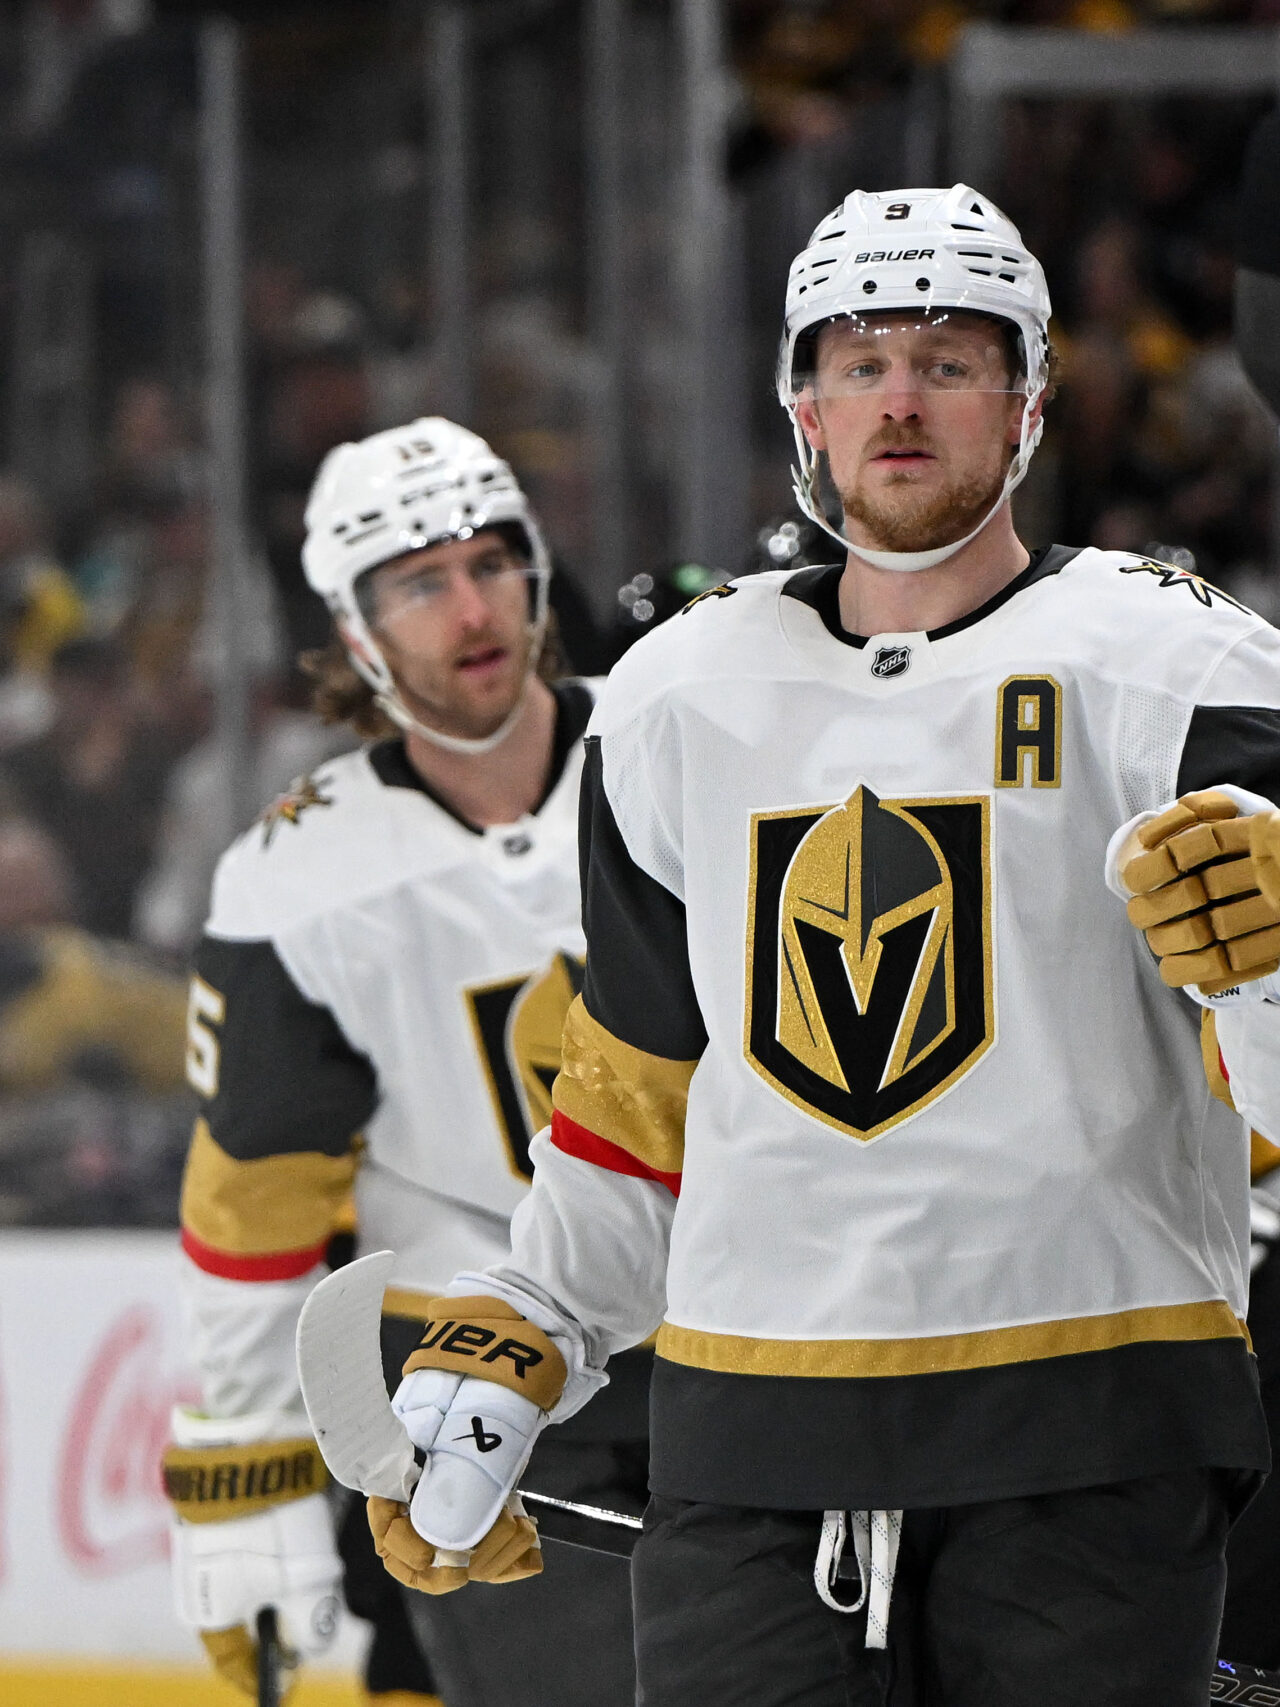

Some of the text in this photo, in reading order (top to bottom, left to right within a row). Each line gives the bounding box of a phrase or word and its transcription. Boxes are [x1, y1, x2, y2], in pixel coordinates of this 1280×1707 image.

[884, 203, 912, 221] 9
[854, 248, 936, 264] BAUER
[994, 673, 1062, 789] A
[412, 1319, 545, 1381] UER
